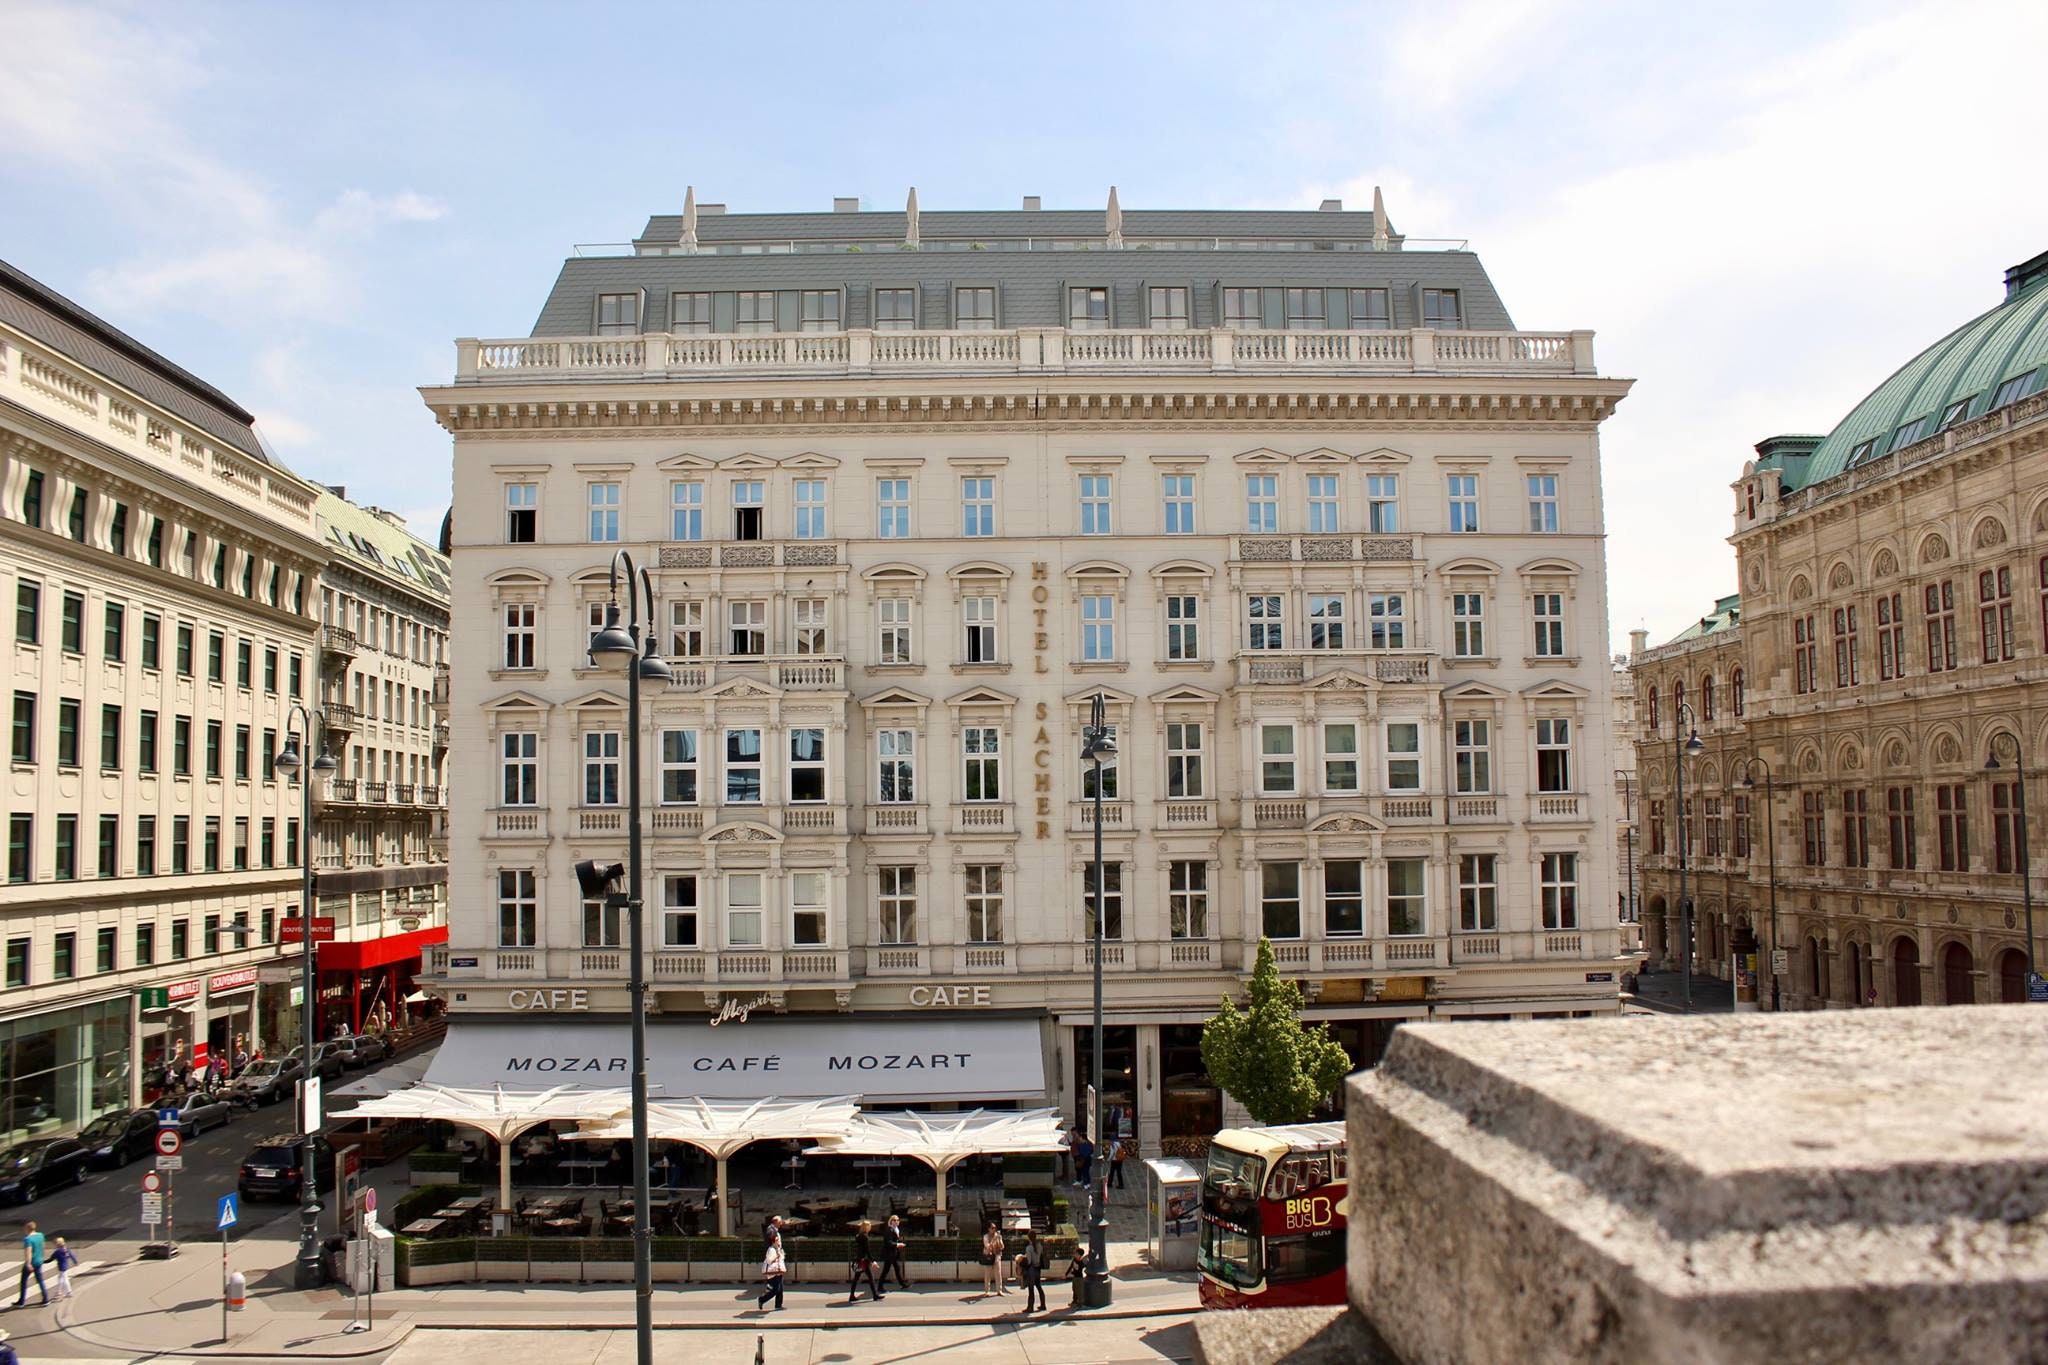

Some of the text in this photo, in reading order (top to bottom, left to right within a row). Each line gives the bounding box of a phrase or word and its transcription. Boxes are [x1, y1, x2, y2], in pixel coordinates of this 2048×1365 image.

[1031, 561, 1051, 839] HOTEL SACHER
[909, 986, 991, 1006] CAFE
[710, 992, 770, 1026] Mozart
[506, 1054, 971, 1071] MOZAR CAFÉ MOZART
[1286, 1199, 1311, 1215] BIG
[1286, 1213, 1312, 1229] BUS
